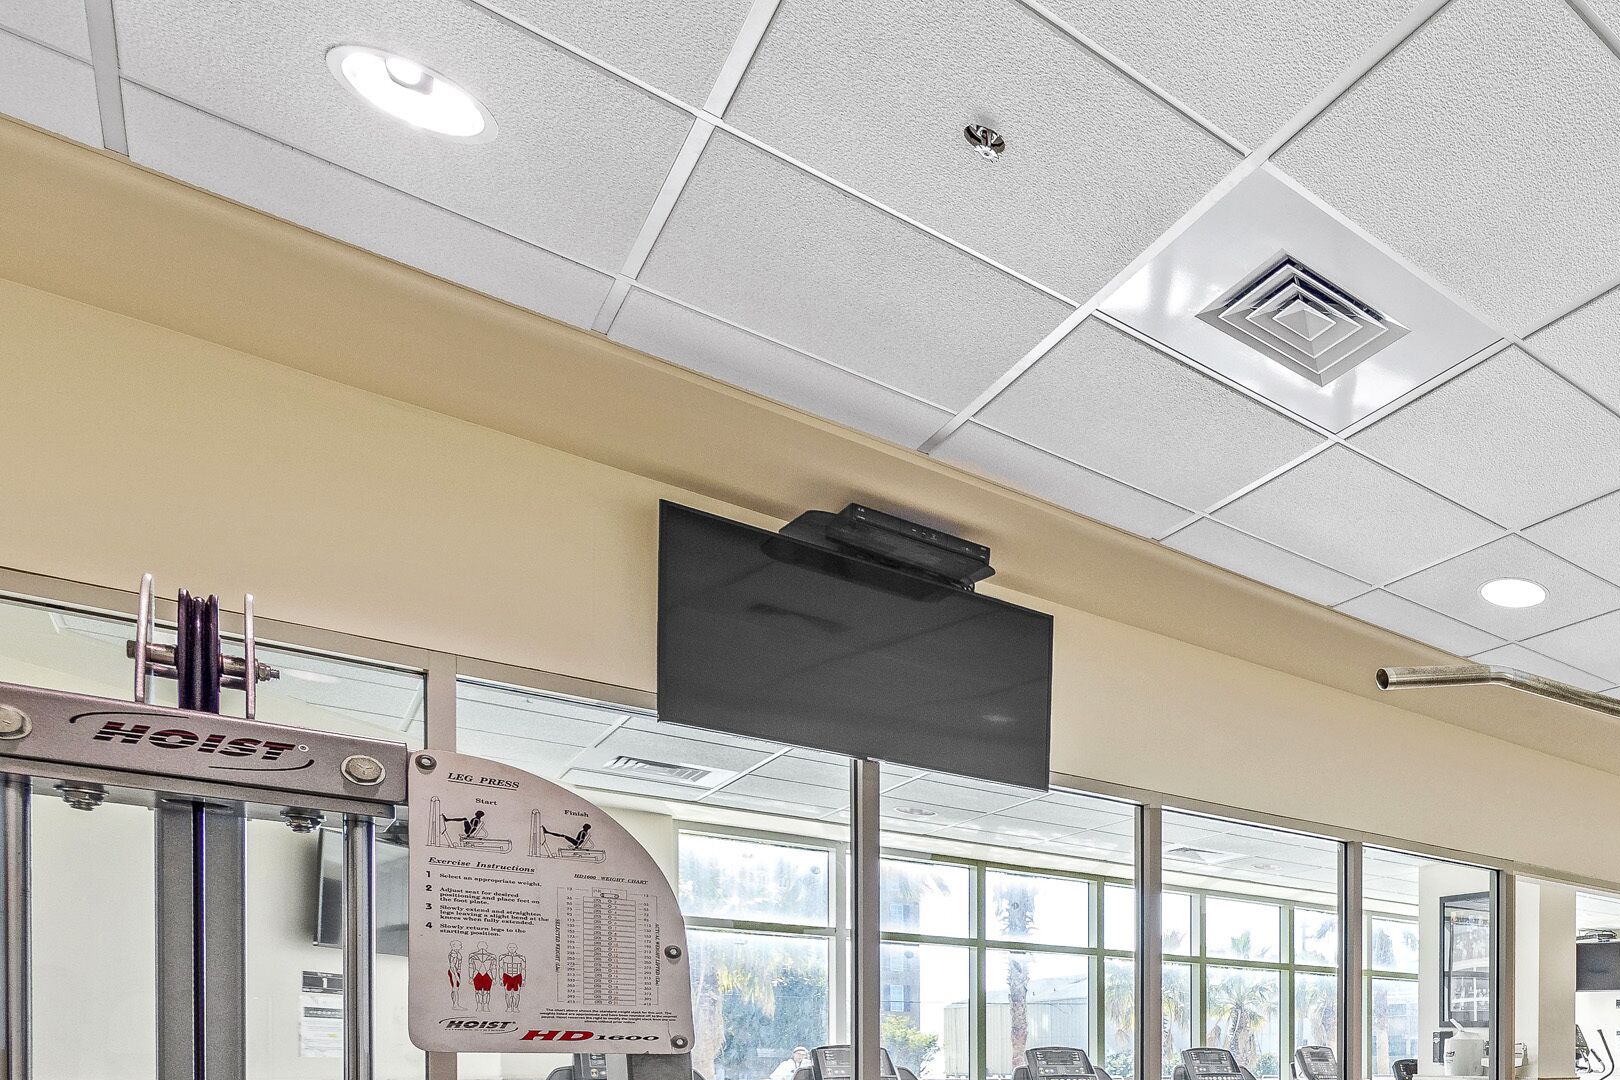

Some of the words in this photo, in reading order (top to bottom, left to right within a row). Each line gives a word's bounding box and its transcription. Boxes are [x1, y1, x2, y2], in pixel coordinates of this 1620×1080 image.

[92, 720, 297, 761] HOIST
[448, 772, 473, 782] LEG
[480, 776, 520, 789] PRESS
[564, 810, 589, 818] Finish
[428, 856, 471, 866] Exercise
[476, 861, 536, 873] Instructions
[446, 1020, 512, 1028] HOIST
[520, 1030, 594, 1041] HD
